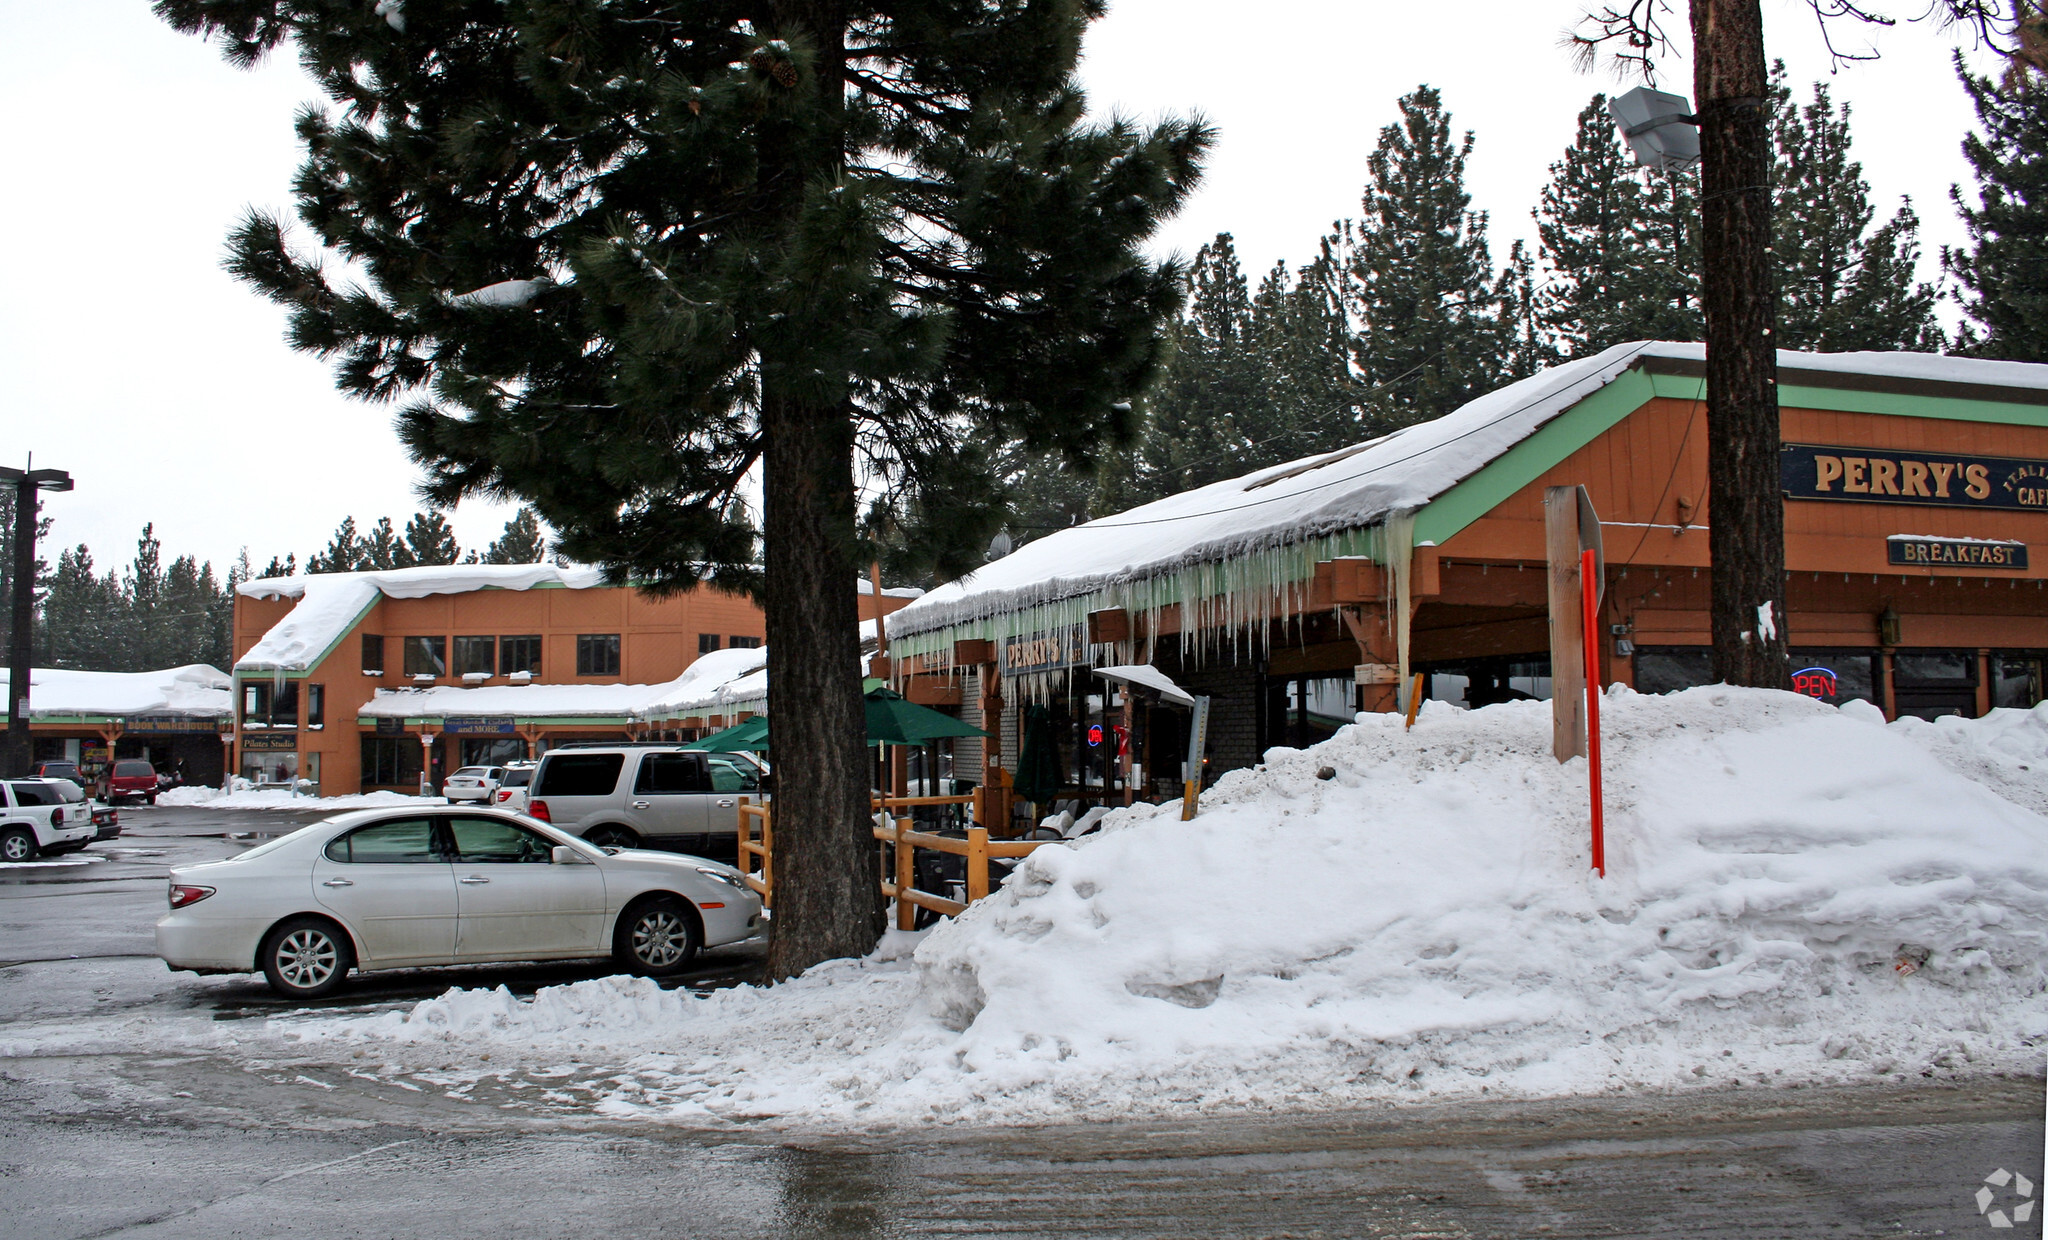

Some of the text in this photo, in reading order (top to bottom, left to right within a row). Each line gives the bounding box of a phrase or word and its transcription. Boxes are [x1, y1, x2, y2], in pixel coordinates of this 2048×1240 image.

[1814, 455, 1991, 500] PERRY'S
[2003, 465, 2048, 492] ITALI
[2018, 487, 2048, 505] CAF
[1904, 543, 2014, 565] BREAKFAST
[128, 721, 215, 730] BOOK WAREHOUSE
[474, 725, 500, 733] MORE
[244, 739, 294, 748] Pilates Studio
